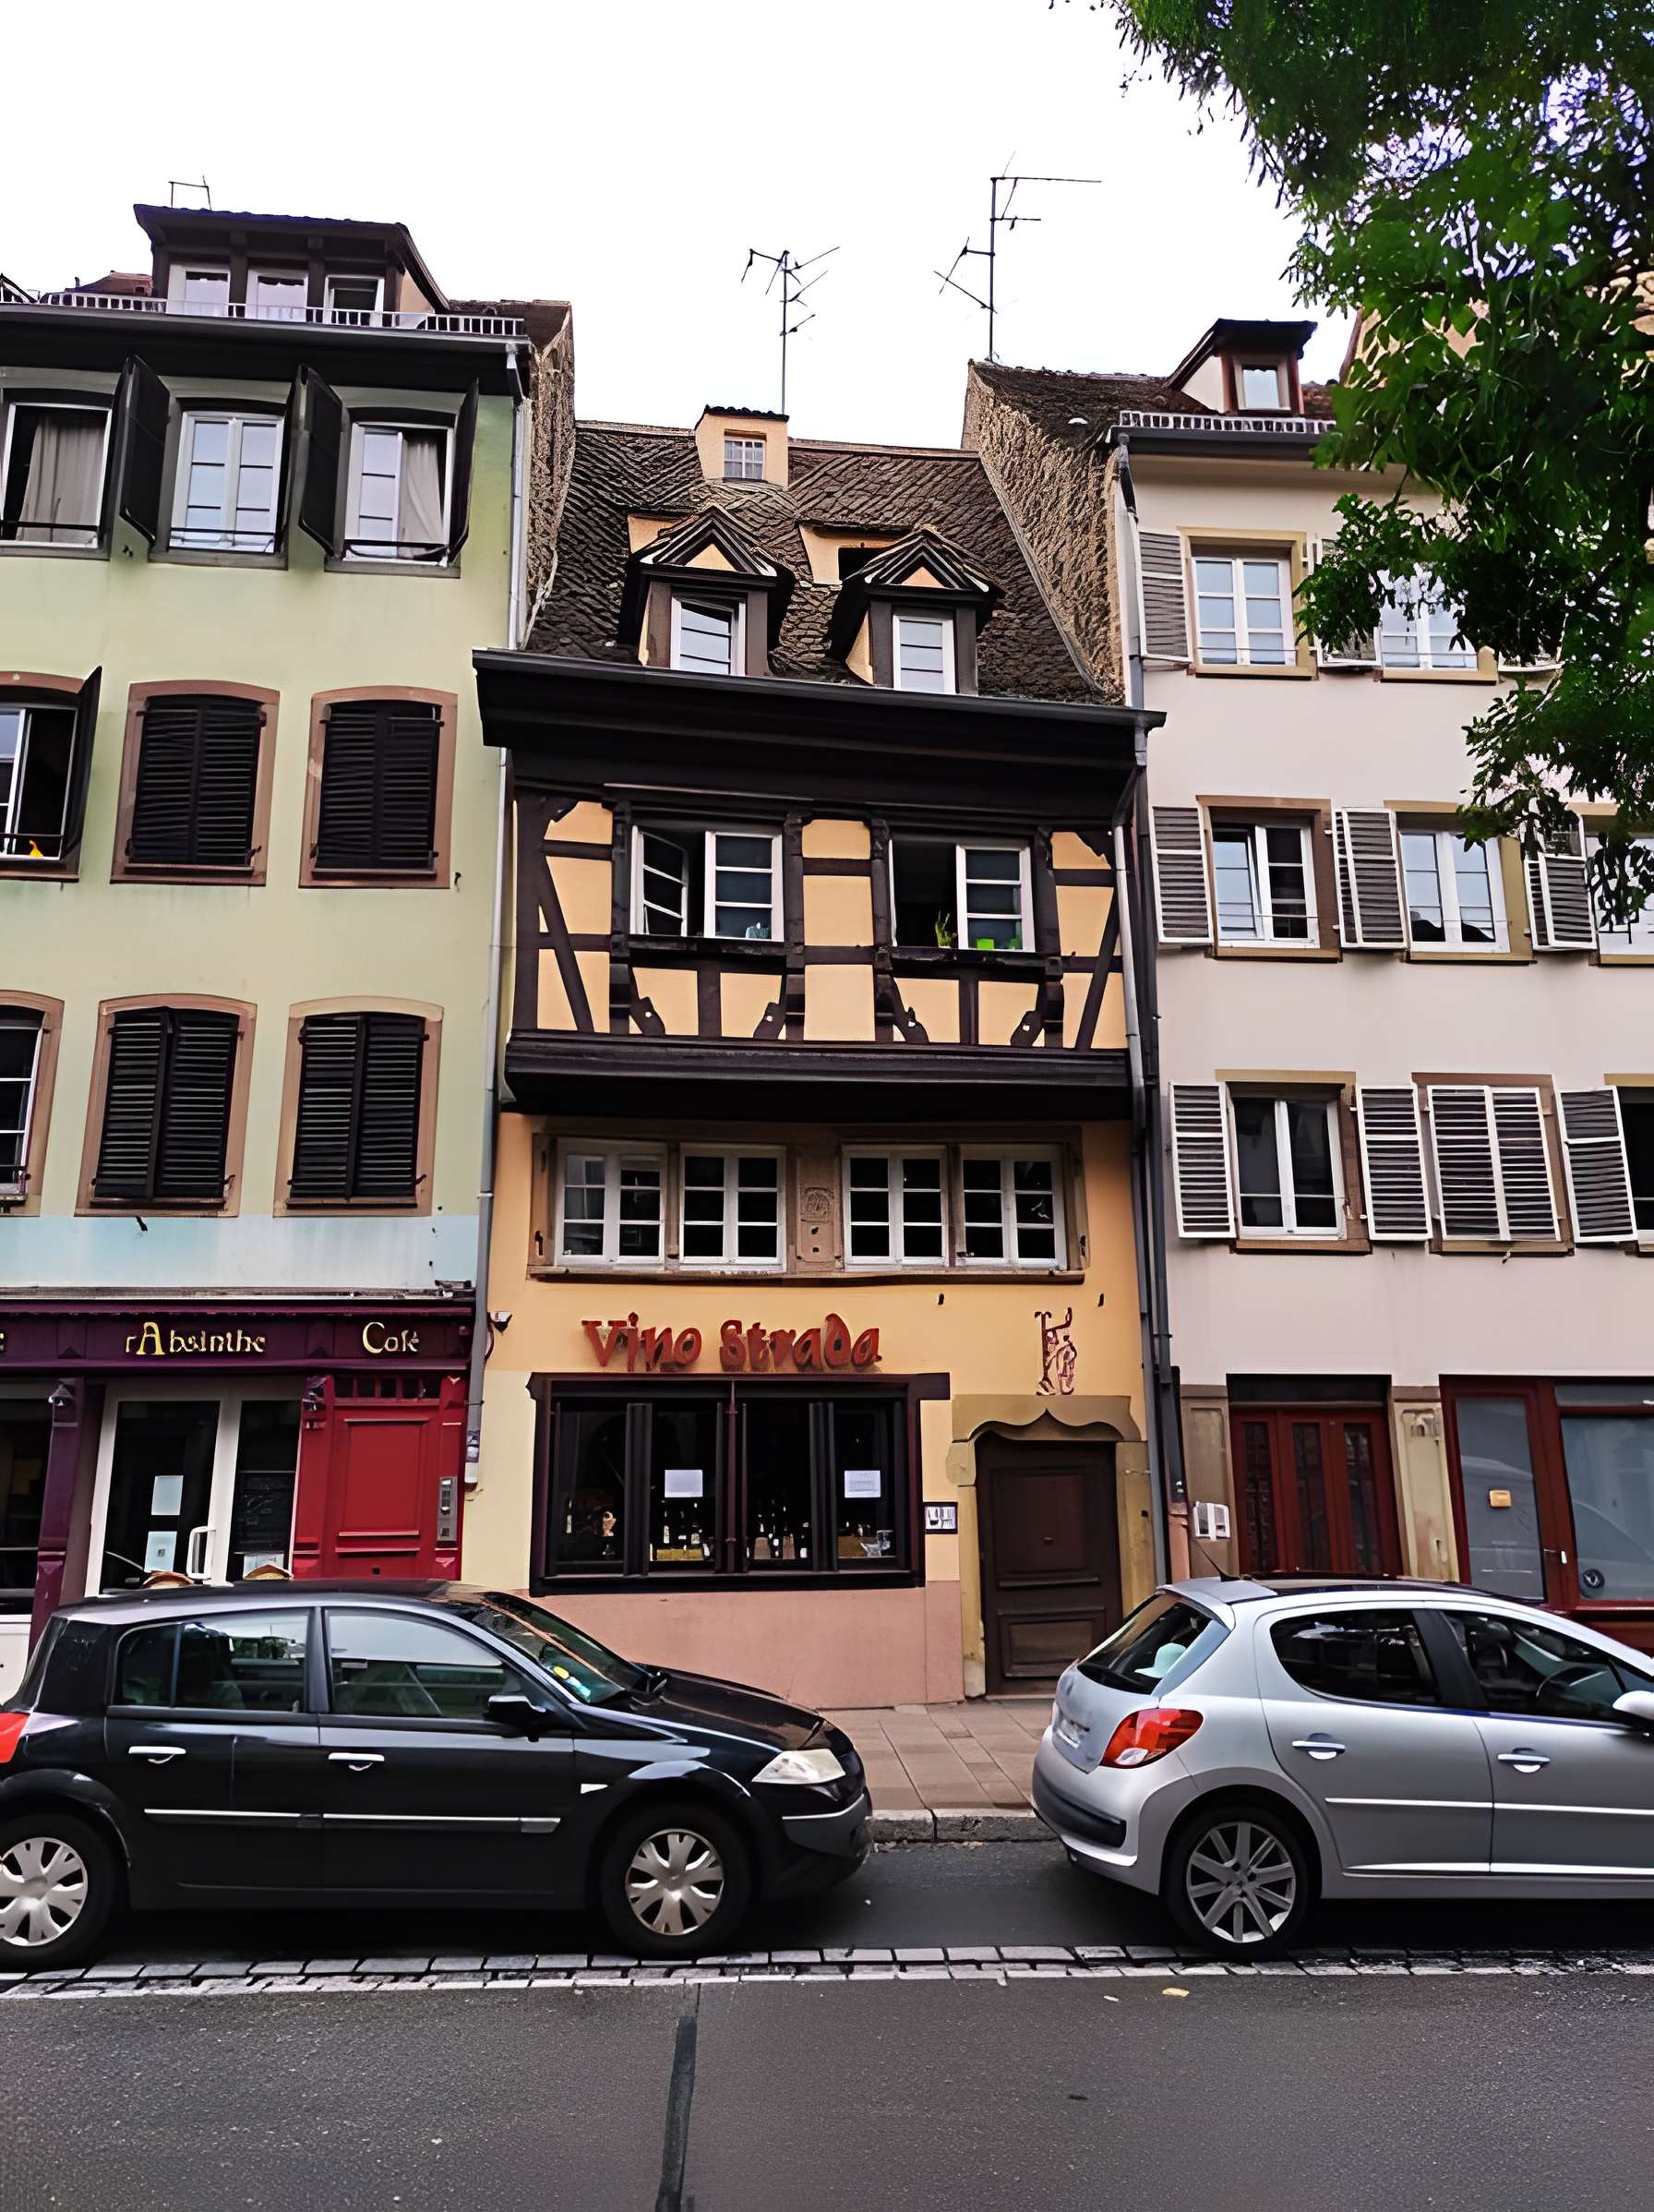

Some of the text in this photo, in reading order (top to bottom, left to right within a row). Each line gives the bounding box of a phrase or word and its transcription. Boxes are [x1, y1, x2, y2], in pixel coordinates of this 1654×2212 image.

[362, 1321, 421, 1354] Café
[581, 1312, 882, 1372] Vino Strada
